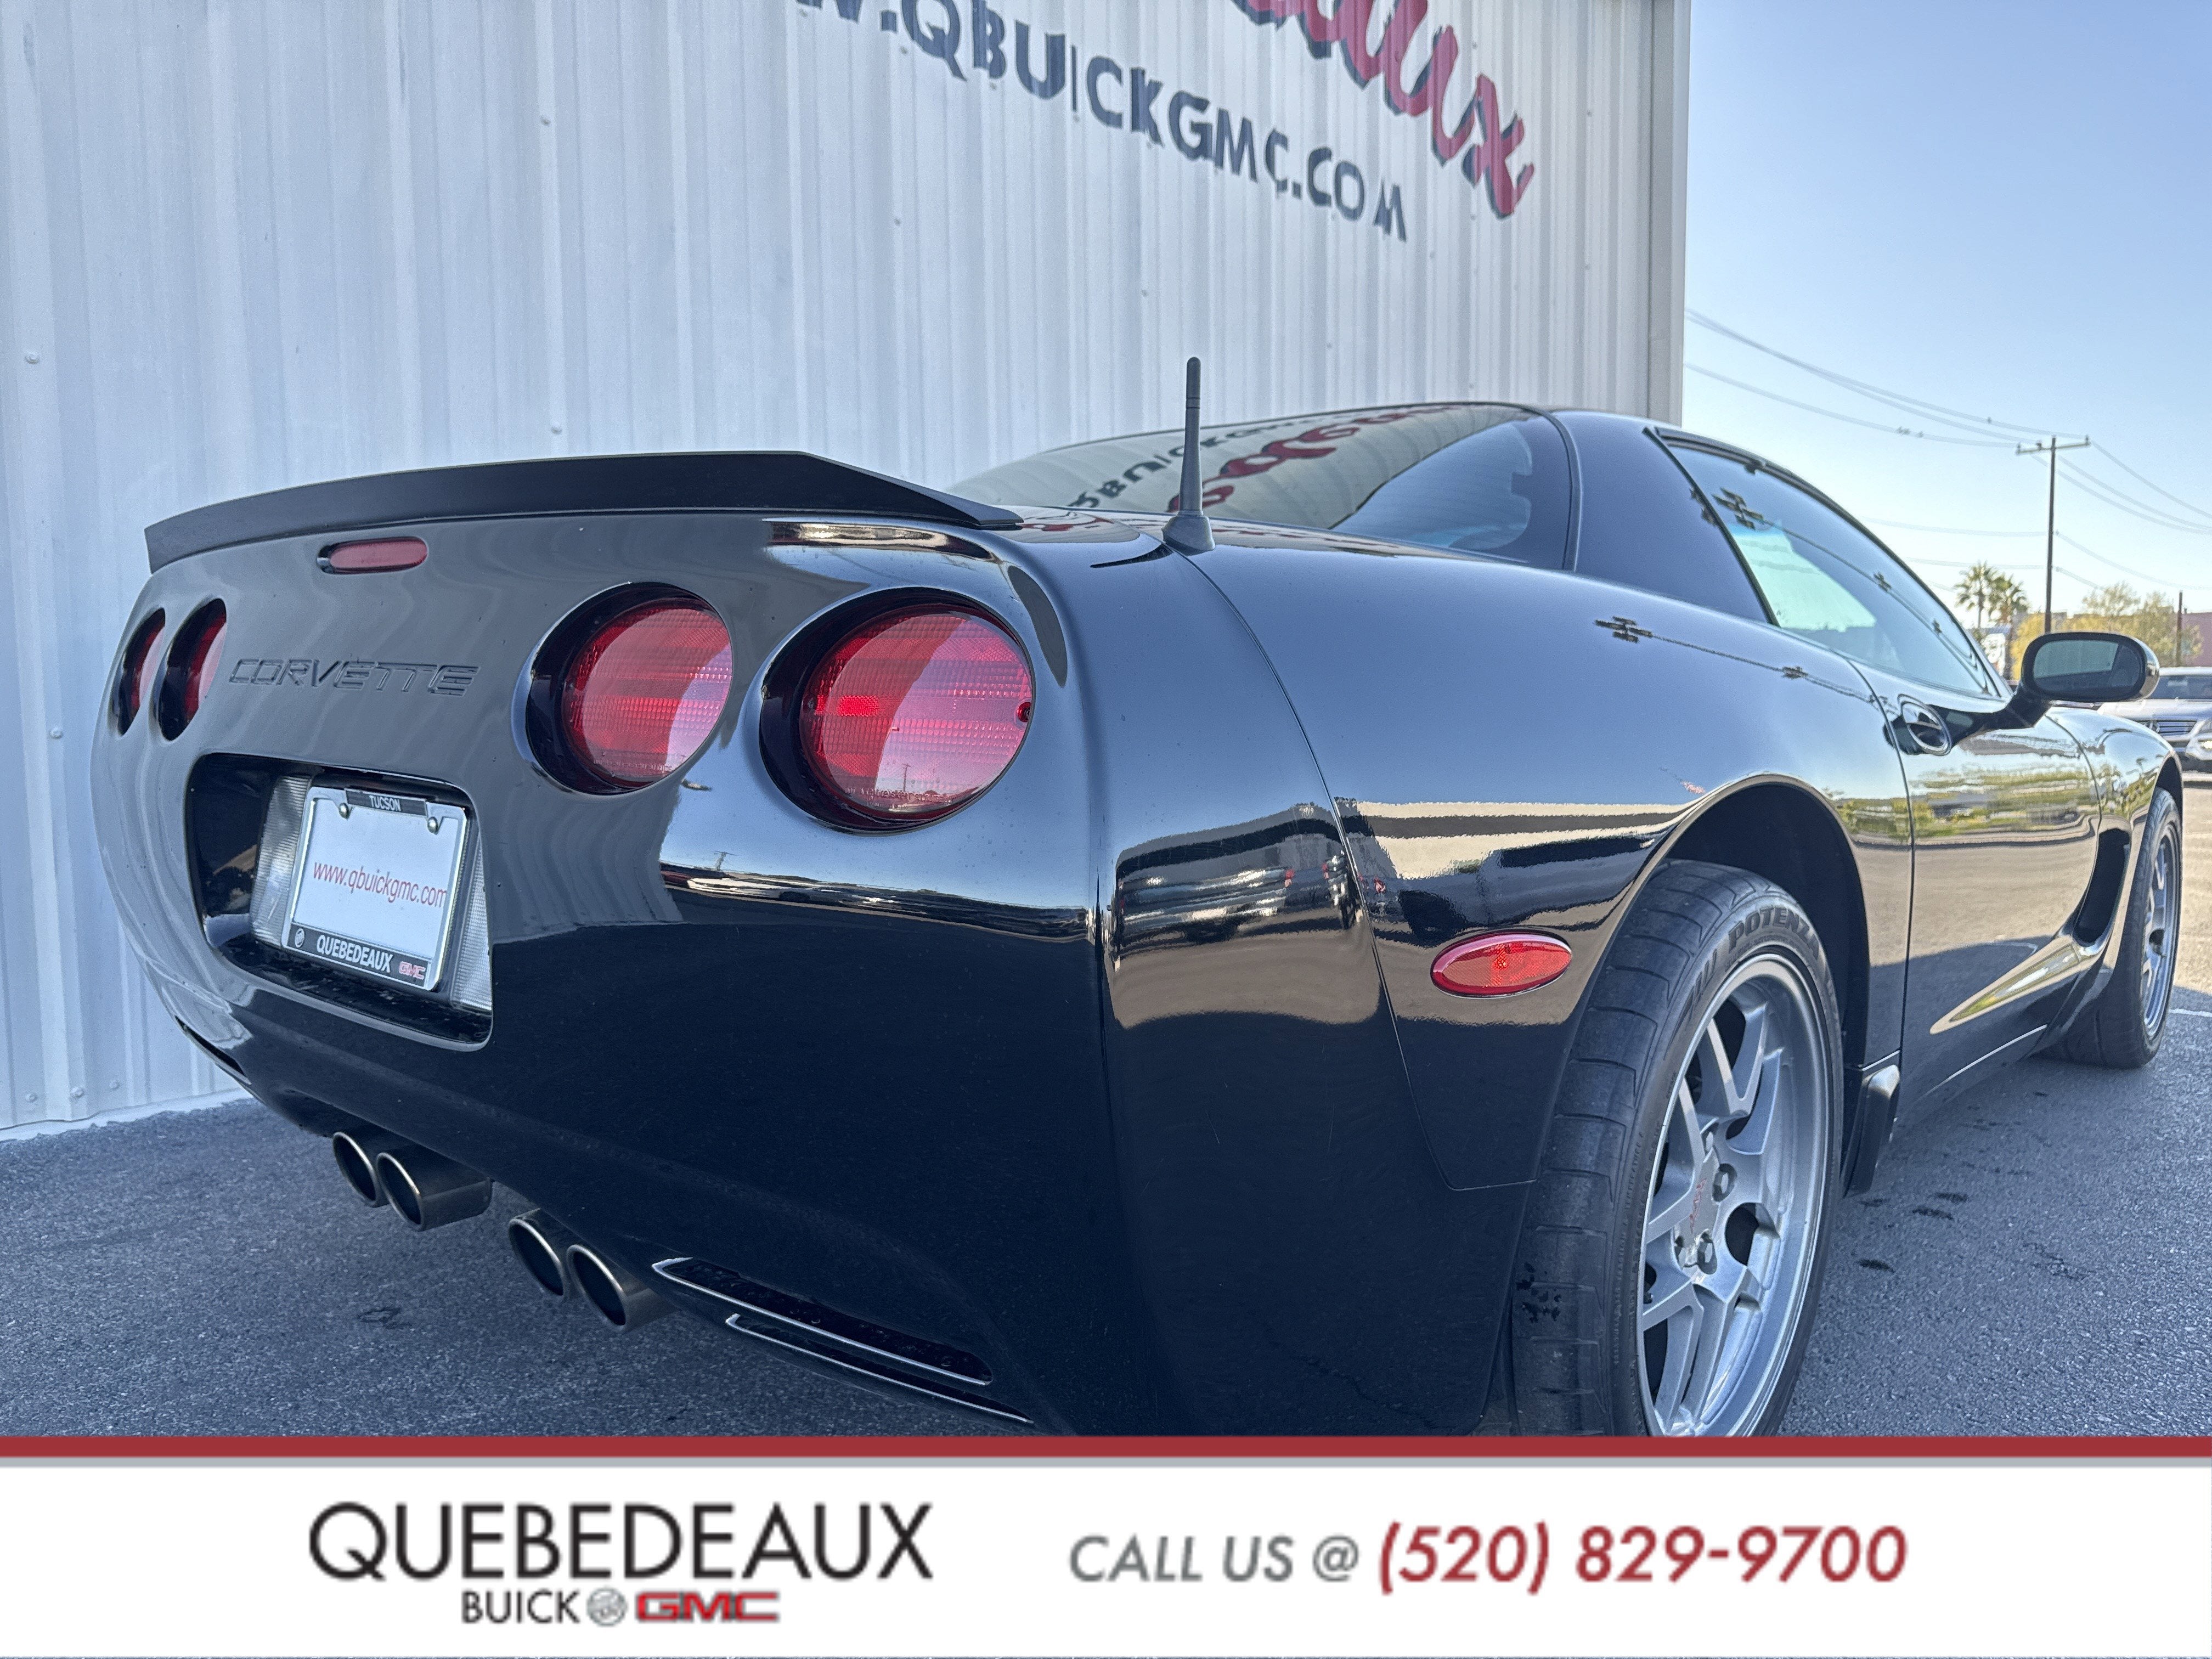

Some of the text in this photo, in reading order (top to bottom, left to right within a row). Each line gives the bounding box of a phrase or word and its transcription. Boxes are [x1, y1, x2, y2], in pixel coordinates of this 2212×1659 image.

[229, 658, 480, 696] CORVETTE
[369, 795, 402, 812] TUCSON
[1729, 905, 1820, 961] POTENZA
[316, 934, 426, 980] QUEBEDEAUX GMC
